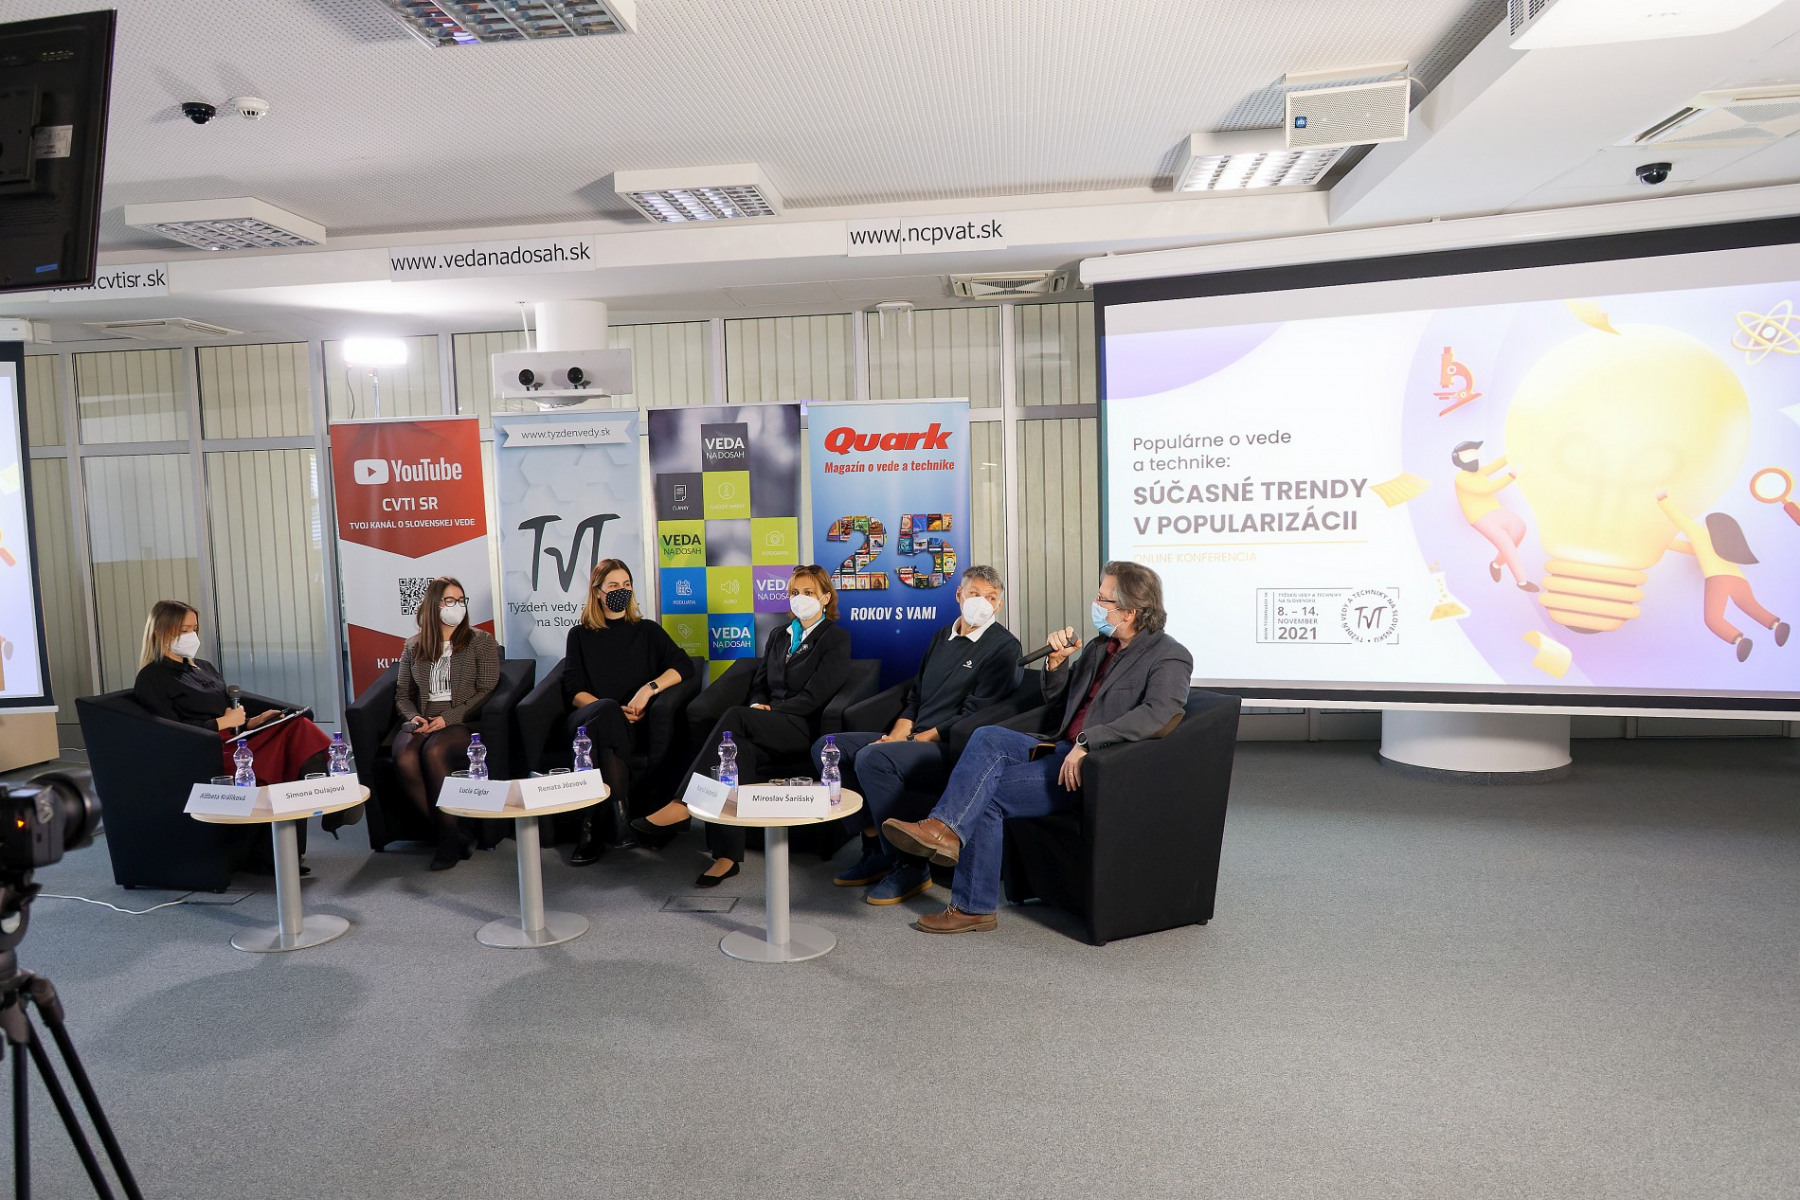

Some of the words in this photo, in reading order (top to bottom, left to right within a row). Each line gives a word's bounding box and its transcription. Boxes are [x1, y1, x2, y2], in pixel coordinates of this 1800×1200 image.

[850, 219, 1003, 246] www.ncpvat.sk
[391, 242, 591, 271] www.vedanadosah.sk
[521, 427, 611, 440] www.tyzdenvedy.sk
[824, 423, 953, 455] Quark
[705, 437, 745, 450] VEDA
[1133, 433, 1224, 454] Populárne
[1229, 435, 1240, 446] o
[1246, 430, 1292, 445] vede
[391, 457, 462, 482] YouTube
[824, 461, 865, 475] Magazín
[868, 464, 874, 472] o
[876, 461, 899, 472] vede
[902, 462, 908, 471] a
[911, 459, 955, 471] technike
[1133, 459, 1144, 472] a
[1149, 455, 1231, 471] technike:
[1133, 476, 1254, 506] SÚČASNÉ
[1260, 478, 1368, 501] TRENDY
[382, 497, 415, 512] CVTI
[420, 496, 438, 511] SR
[349, 522, 369, 530] TVOJ
[370, 520, 397, 529] KANÁL
[398, 520, 404, 528] O
[405, 519, 453, 528] SLOVENSKEJ
[454, 518, 475, 526] VEDE
[1133, 517, 1151, 535] V
[1157, 505, 1358, 535] POPULARIZÁCII
[662, 534, 701, 546] VEDA
[827, 514, 957, 590] 25
[1133, 553, 1173, 564] ONLINE
[1177, 552, 1257, 563] KONFERENCIA
[507, 602, 548, 615] Týždeň
[551, 602, 578, 614] vedy
[850, 607, 892, 621] ROKOV
[895, 607, 903, 620] S
[906, 607, 937, 620] VAMI
[1278, 607, 1288, 616] 8.
[1302, 607, 1319, 616] 14.
[537, 618, 551, 627] na
[712, 627, 751, 639] VEDA
[1278, 627, 1317, 640] 2021
[285, 790, 313, 799] Simona
[314, 784, 345, 797] Dulajová
[752, 794, 784, 802] Miroslav
